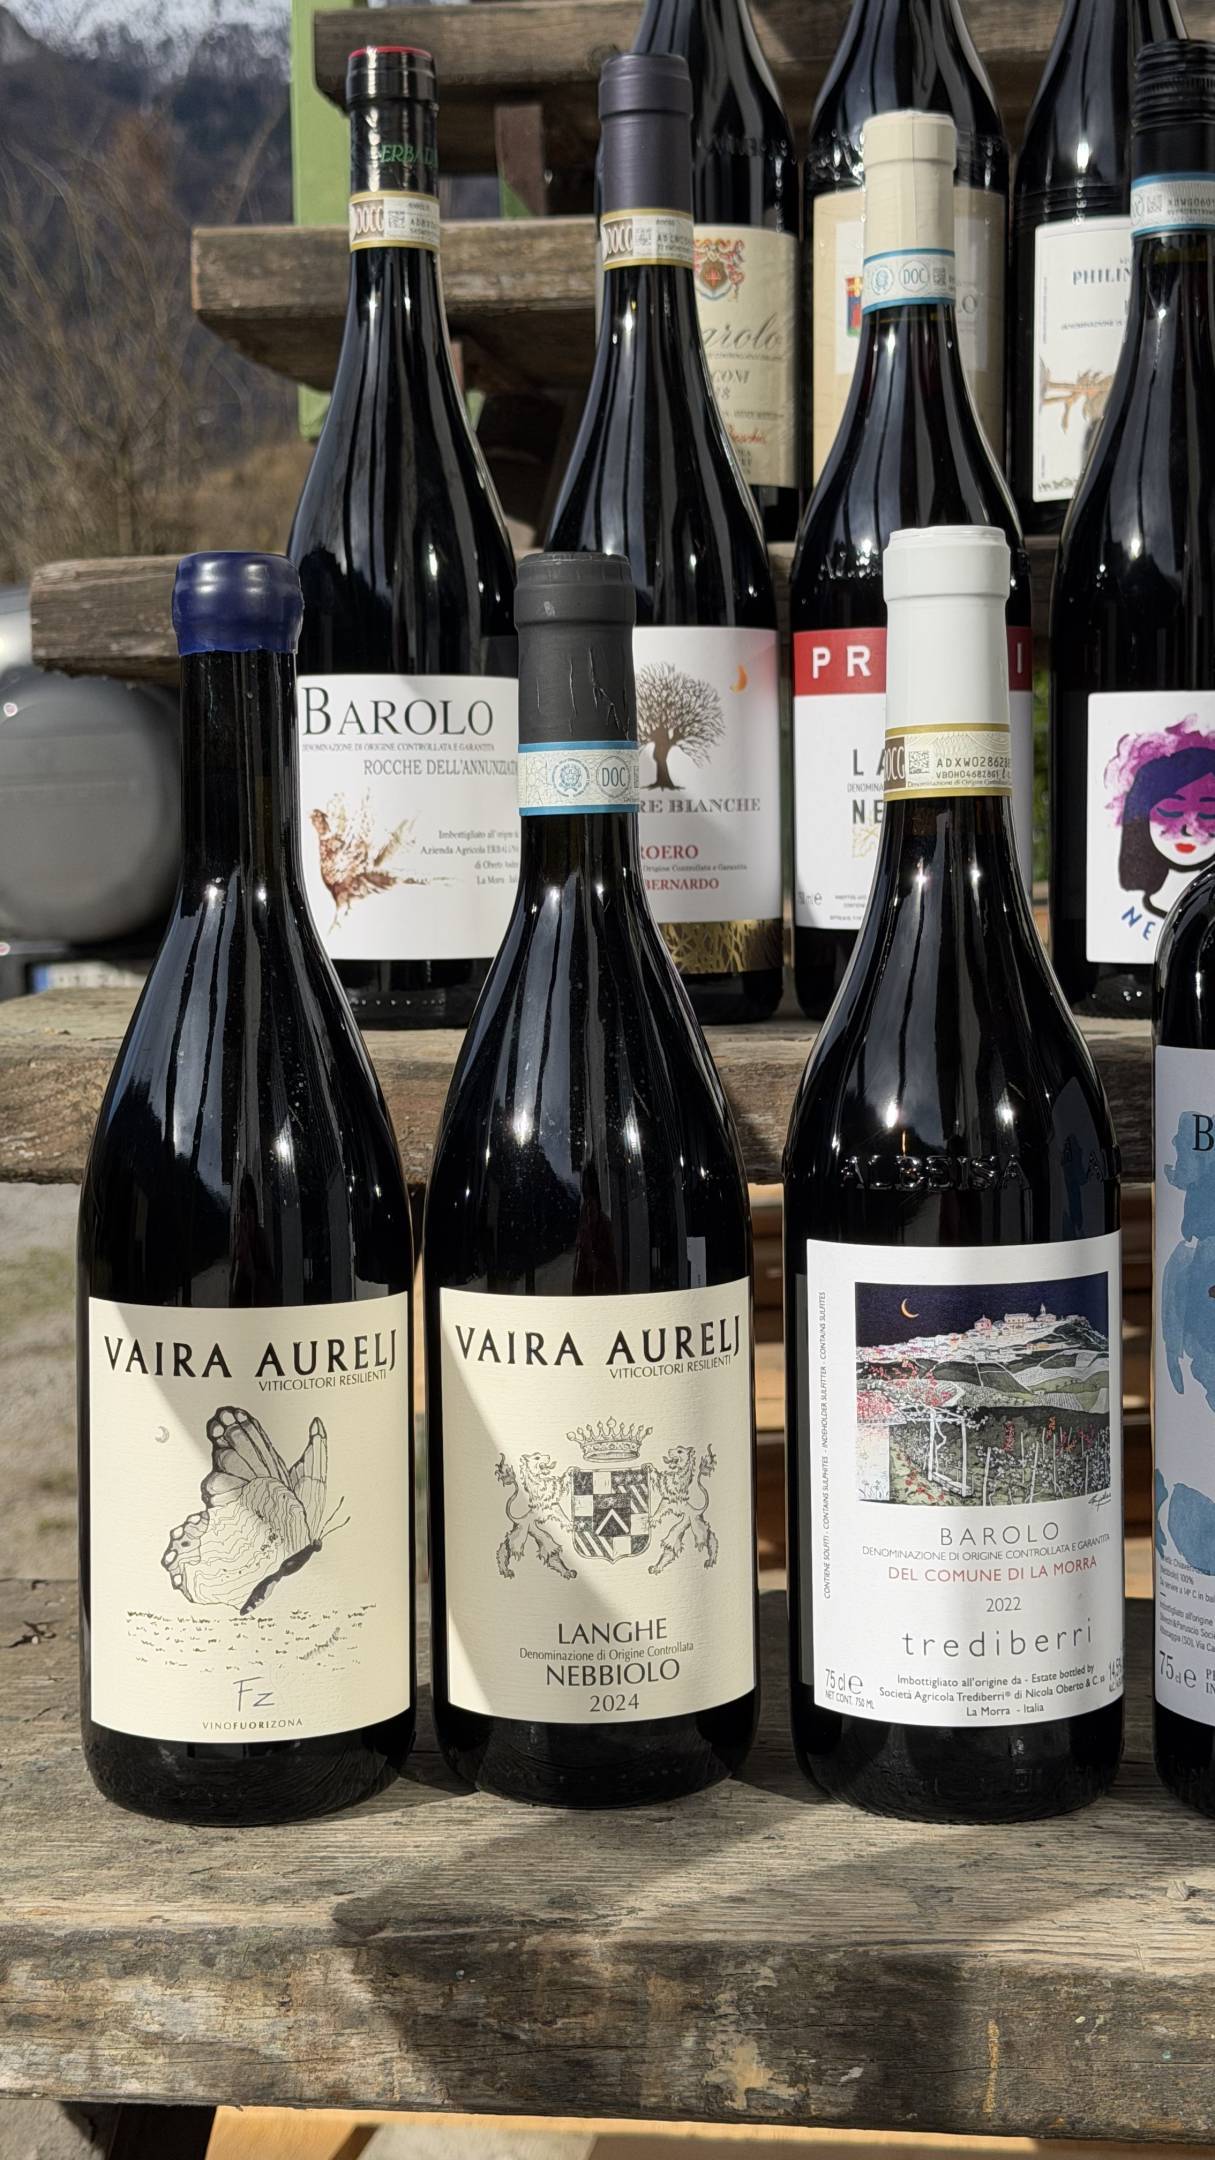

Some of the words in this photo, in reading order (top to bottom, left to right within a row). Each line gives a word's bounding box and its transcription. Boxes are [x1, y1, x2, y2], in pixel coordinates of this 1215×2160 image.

[903, 268, 925, 285] DOC
[363, 759, 423, 776] ROCCHE
[601, 767, 626, 787] DOC
[668, 797, 761, 814] BIANCHE
[420, 845, 453, 855] Azienda
[672, 863, 712, 873] Controllata
[818, 1291, 826, 1321] SULFITES
[455, 1325, 584, 1366] VAIRA
[819, 1322, 827, 1360] CONTAINS
[104, 1335, 232, 1378] VAIRA
[609, 1363, 684, 1380] VITICOLTORI
[687, 1354, 732, 1373] RESILIENTI
[258, 1376, 336, 1392] VITICOLTORI
[339, 1369, 387, 1386] RESILIENTI
[821, 1456, 829, 1491] SULPHITES
[822, 1492, 830, 1530] CONTAINS
[940, 1521, 1060, 1546] BAROLO
[862, 1545, 946, 1561] DENOMINAZIONE
[949, 1551, 959, 1561] DI
[962, 1550, 1003, 1561] ORIGINE
[1005, 1545, 1070, 1559] CONTROLLATA
[1072, 1543, 1076, 1551] E
[1078, 1533, 1111, 1551] GARANTITA
[888, 1566, 918, 1581] DEL
[924, 1568, 1002, 1582] COMUNE
[1008, 1566, 1024, 1581] DI
[1030, 1564, 1048, 1578] LA
[1053, 1555, 1097, 1576] MORRA
[985, 1596, 1021, 1613] 2022
[558, 1618, 667, 1644] LANGHE
[902, 1617, 1092, 1657] trediberri
[519, 1647, 594, 1661] Denominazione
[596, 1651, 606, 1661] di
[608, 1649, 645, 1663] Origine
[647, 1641, 694, 1657] Controllata
[546, 1658, 680, 1687] NEBBIOLO
[897, 1674, 959, 1689] Imbottigliato
[961, 1677, 1008, 1689] all'origine
[1011, 1675, 1022, 1686] da
[1031, 1673, 1057, 1684] Estate
[1059, 1665, 1086, 1680] bottled
[1087, 1663, 1094, 1676] by
[1160, 1650, 1173, 1680] 75
[825, 1668, 836, 1689] 75
[838, 1672, 846, 1691] cl
[879, 1686, 912, 1700] Società
[914, 1690, 954, 1704] Agricola
[1014, 1690, 1022, 1700] di
[1025, 1686, 1053, 1699] Nicola
[1056, 1682, 1084, 1695] Oberto
[1085, 1680, 1090, 1688] &
[589, 1693, 640, 1712] 2024
[966, 1707, 977, 1717] La
[980, 1706, 1010, 1716] Morra
[1023, 1703, 1044, 1714] Italia
[202, 1718, 303, 1730] VINOFUORIZONA
